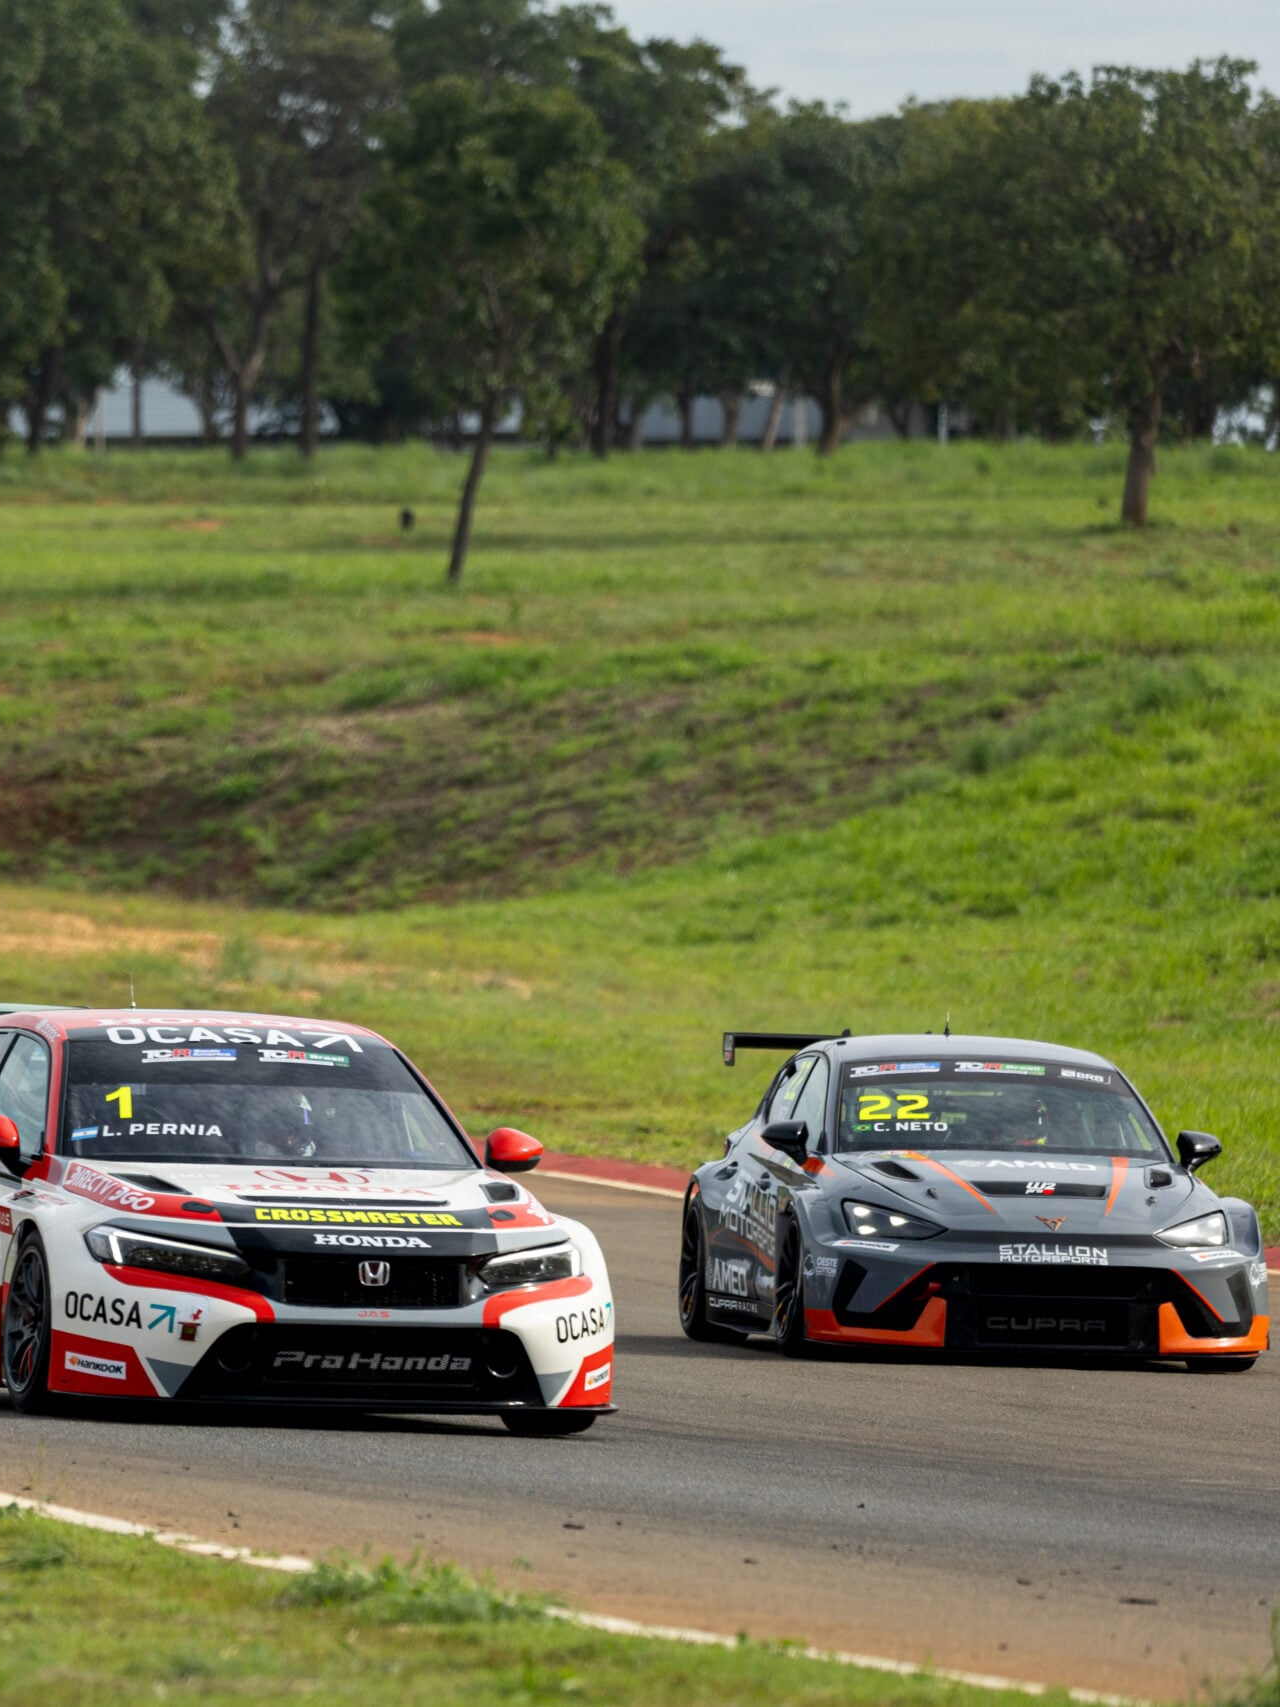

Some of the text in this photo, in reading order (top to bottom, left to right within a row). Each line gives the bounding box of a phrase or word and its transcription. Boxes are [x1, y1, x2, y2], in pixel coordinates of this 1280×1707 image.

[106, 1026, 305, 1047] OCASA
[142, 1048, 191, 1059] TCR
[258, 1049, 306, 1060] TCR
[1074, 1072, 1104, 1083] BRB
[105, 1087, 133, 1119] 1
[858, 1095, 931, 1120] 22
[102, 1123, 223, 1137] L. PERNIA
[874, 1122, 948, 1132] C. NETO
[986, 1159, 1097, 1171] AMED
[66, 1165, 114, 1196] DIRECTV
[255, 1207, 463, 1226] CROSSMASTER
[314, 1233, 431, 1248] HONDA
[999, 1244, 1108, 1258] STALLION
[999, 1254, 1109, 1265] MOTORSPORTS
[712, 1258, 748, 1297] AMED
[65, 1291, 143, 1329] OCASA
[357, 1310, 391, 1318] JAS
[556, 1306, 605, 1343] OCASA
[986, 1317, 1107, 1331] CUPRA
